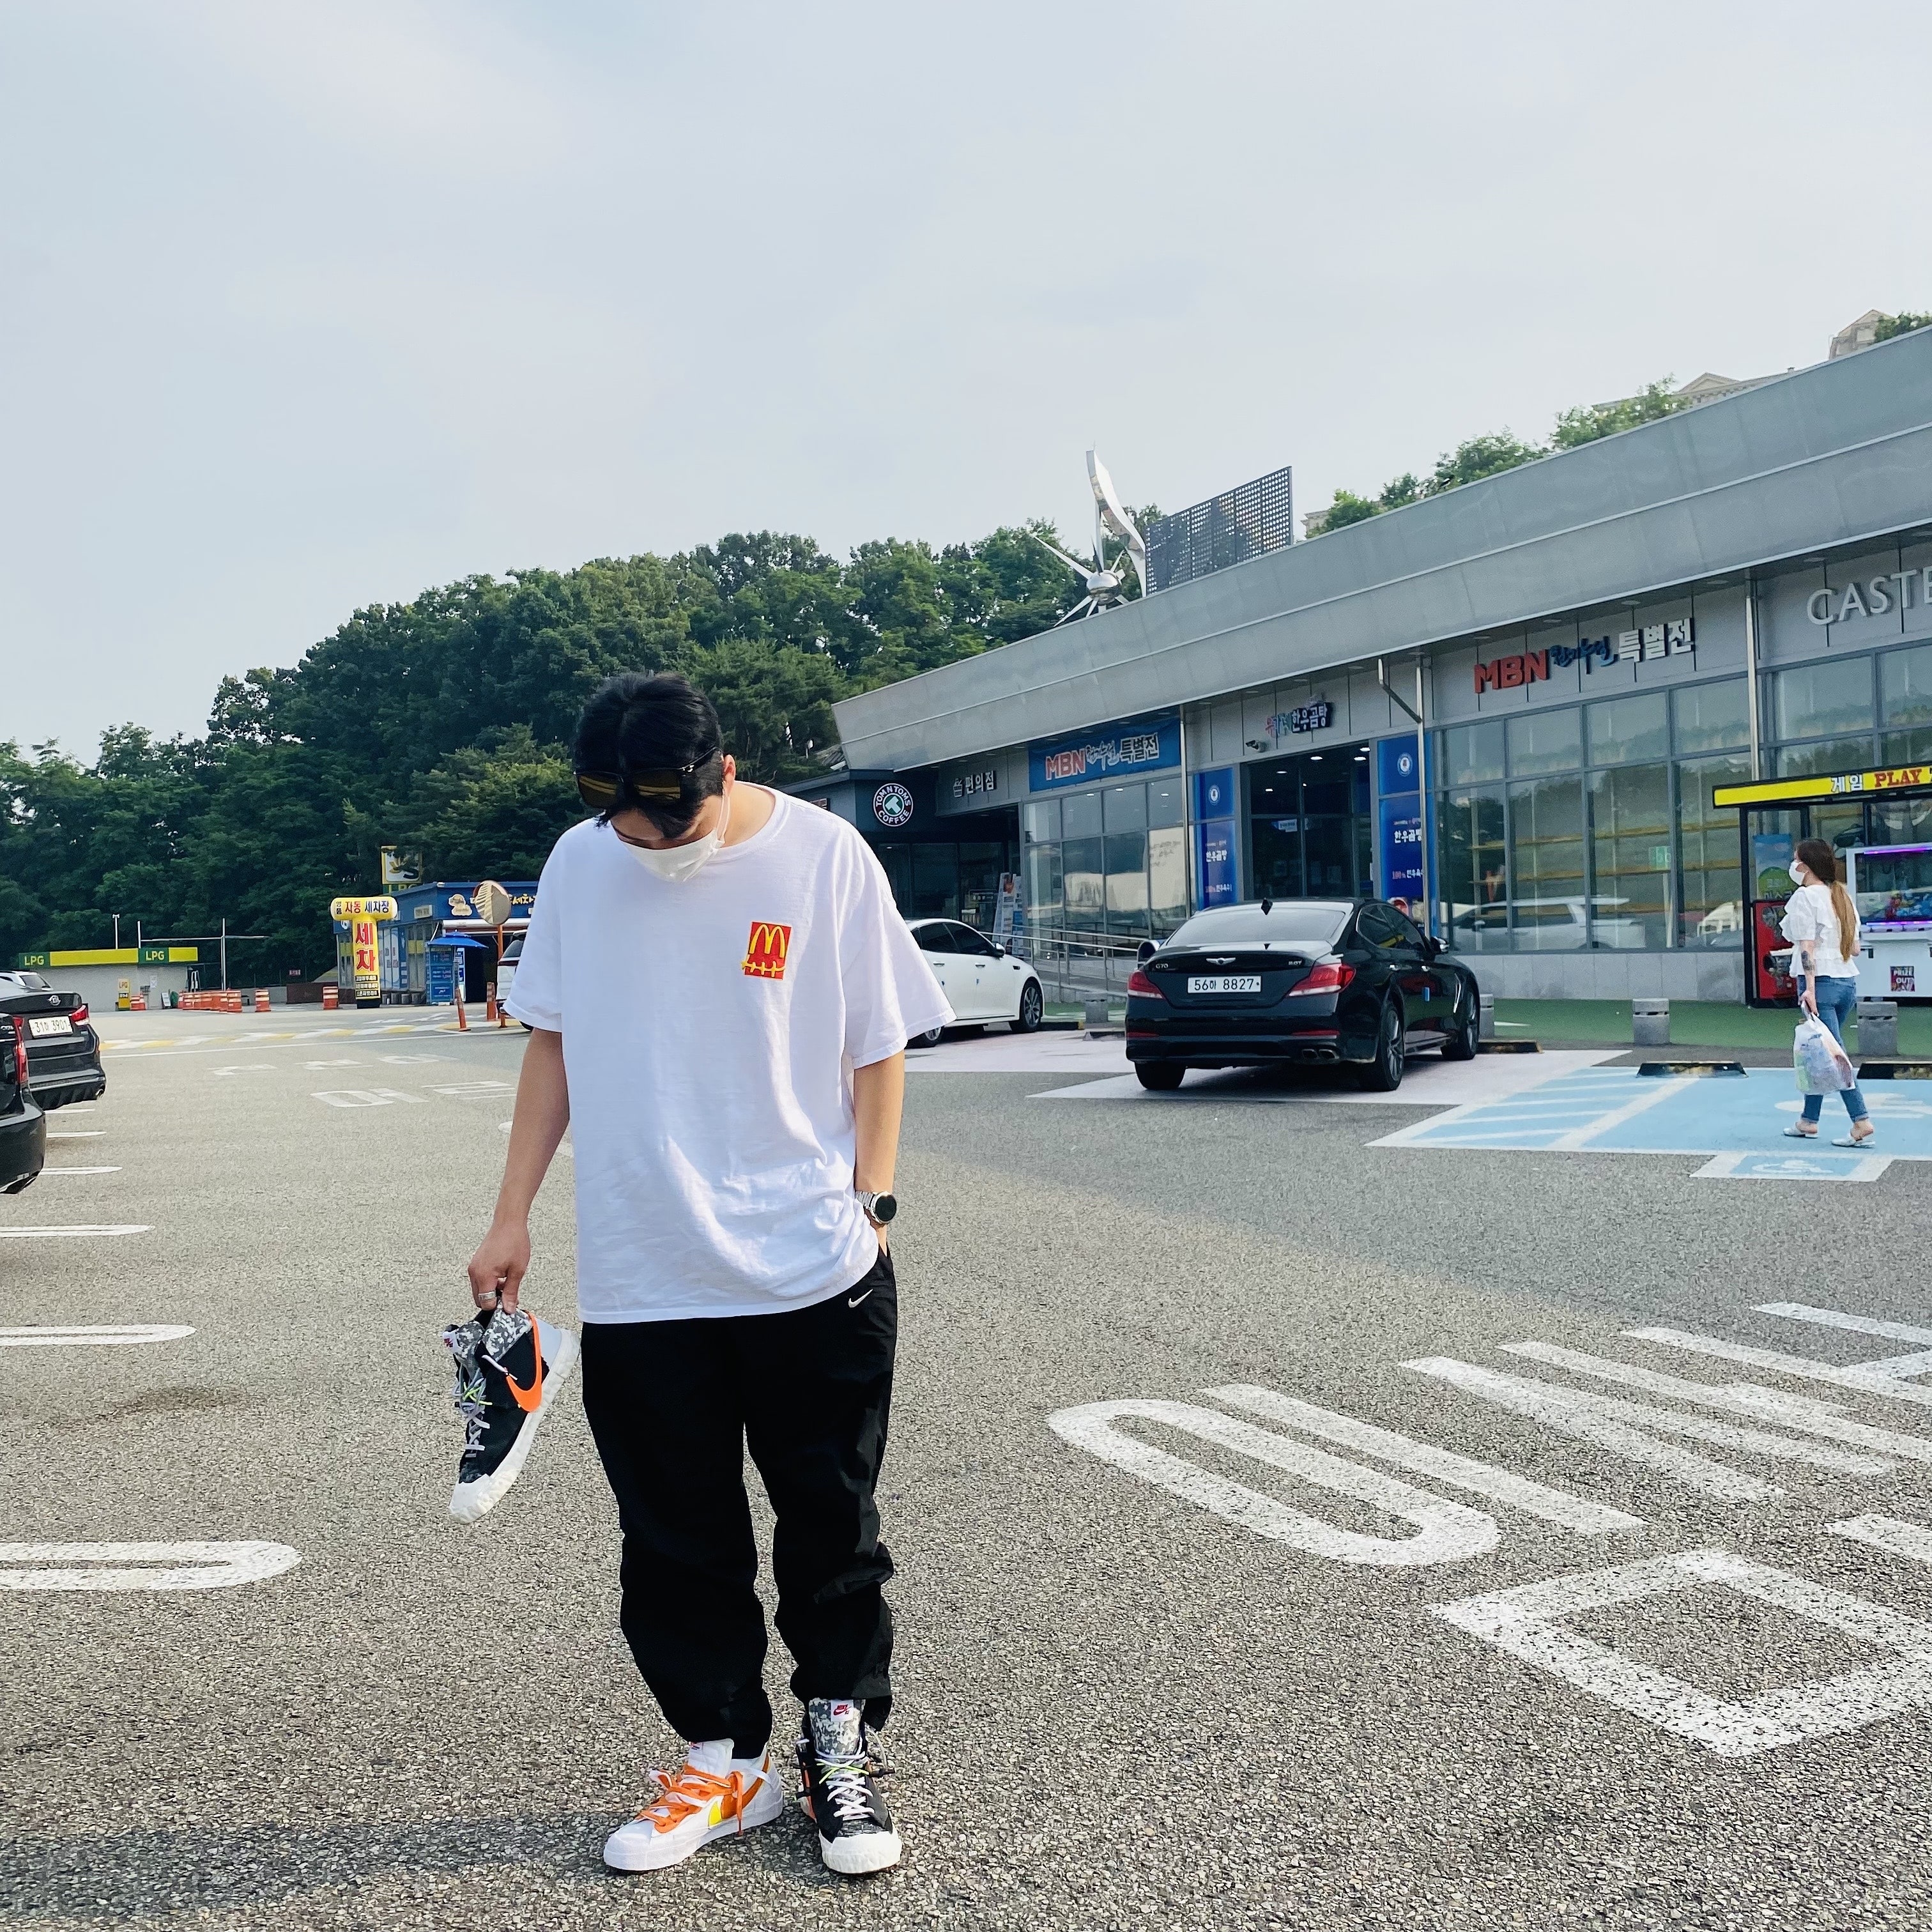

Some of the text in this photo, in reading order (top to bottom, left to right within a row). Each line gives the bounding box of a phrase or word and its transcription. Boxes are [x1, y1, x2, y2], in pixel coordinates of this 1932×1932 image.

[1474, 649, 1548, 694] MBN
[1619, 618, 1693, 662] 특별전
[1292, 702, 1328, 732] 한우곰탕
[1045, 747, 1085, 781] MBN
[1120, 732, 1160, 764] 특별전
[965, 770, 994, 794] 편의점
[1831, 774, 1864, 793] 게임
[1874, 768, 1922, 788] PLAY
[893, 786, 911, 806] TOMS
[878, 809, 910, 824] COFFEE
[345, 901, 360, 914] 자동
[365, 900, 389, 914] 세차장
[143, 951, 164, 961] LPG
[355, 922, 376, 972] 세차
[24, 956, 44, 965] LPG
[1223, 978, 1254, 990] 8827
[51, 1019, 68, 1031] 3901
